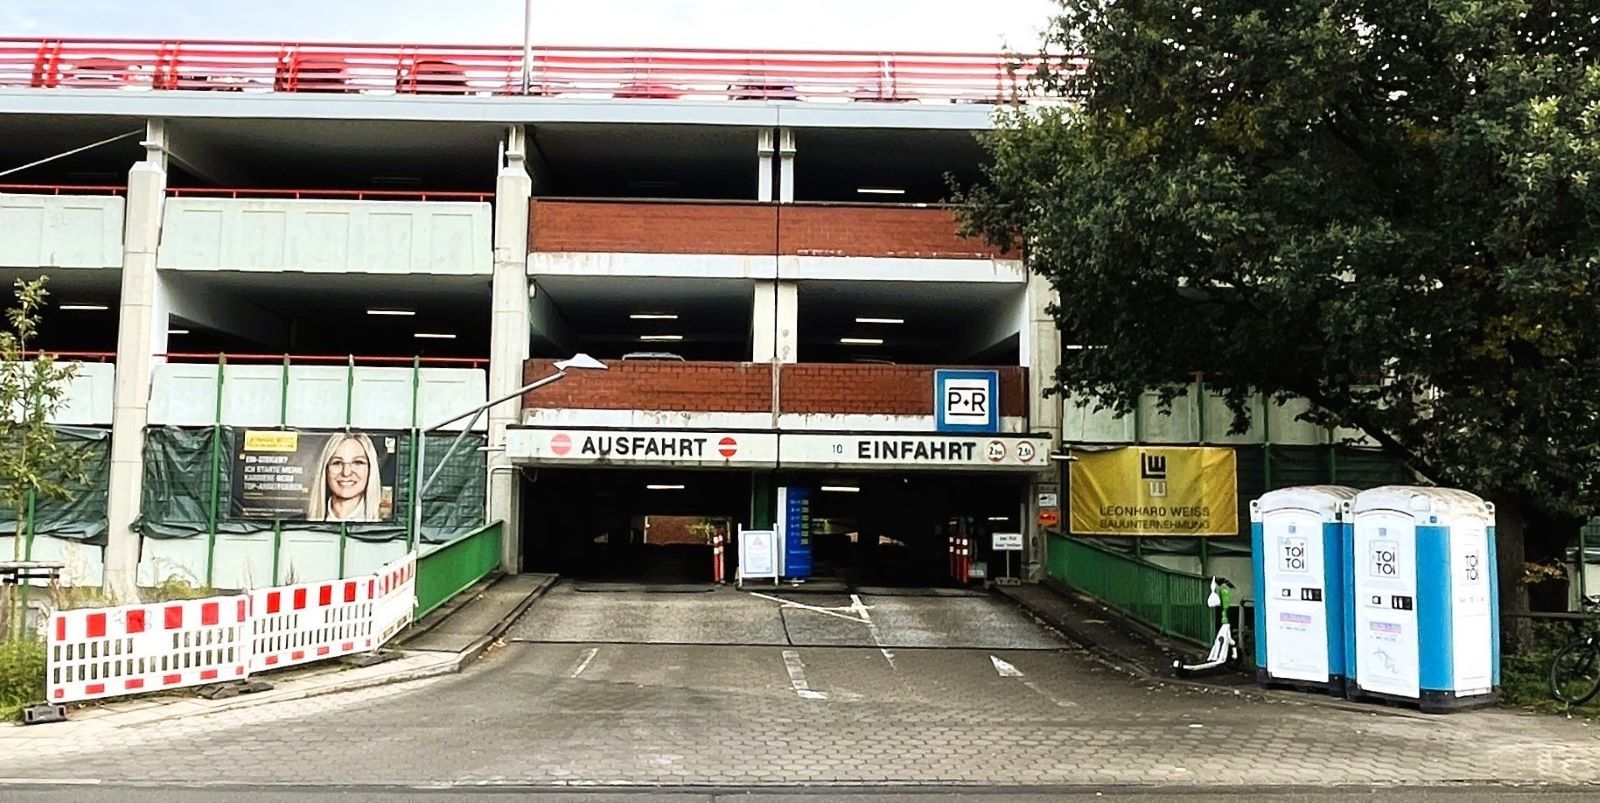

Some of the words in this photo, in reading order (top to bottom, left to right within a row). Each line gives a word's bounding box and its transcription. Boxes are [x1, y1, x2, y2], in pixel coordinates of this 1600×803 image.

[948, 392, 985, 412] P+R
[581, 437, 707, 457] AUSFAHRT
[832, 444, 843, 454] 10
[858, 441, 977, 460] EINFAHRT
[1099, 505, 1167, 517] LEONHARD
[1170, 506, 1210, 517] WEISS
[1099, 519, 1210, 529] BAUUNTERNEHMUNG
